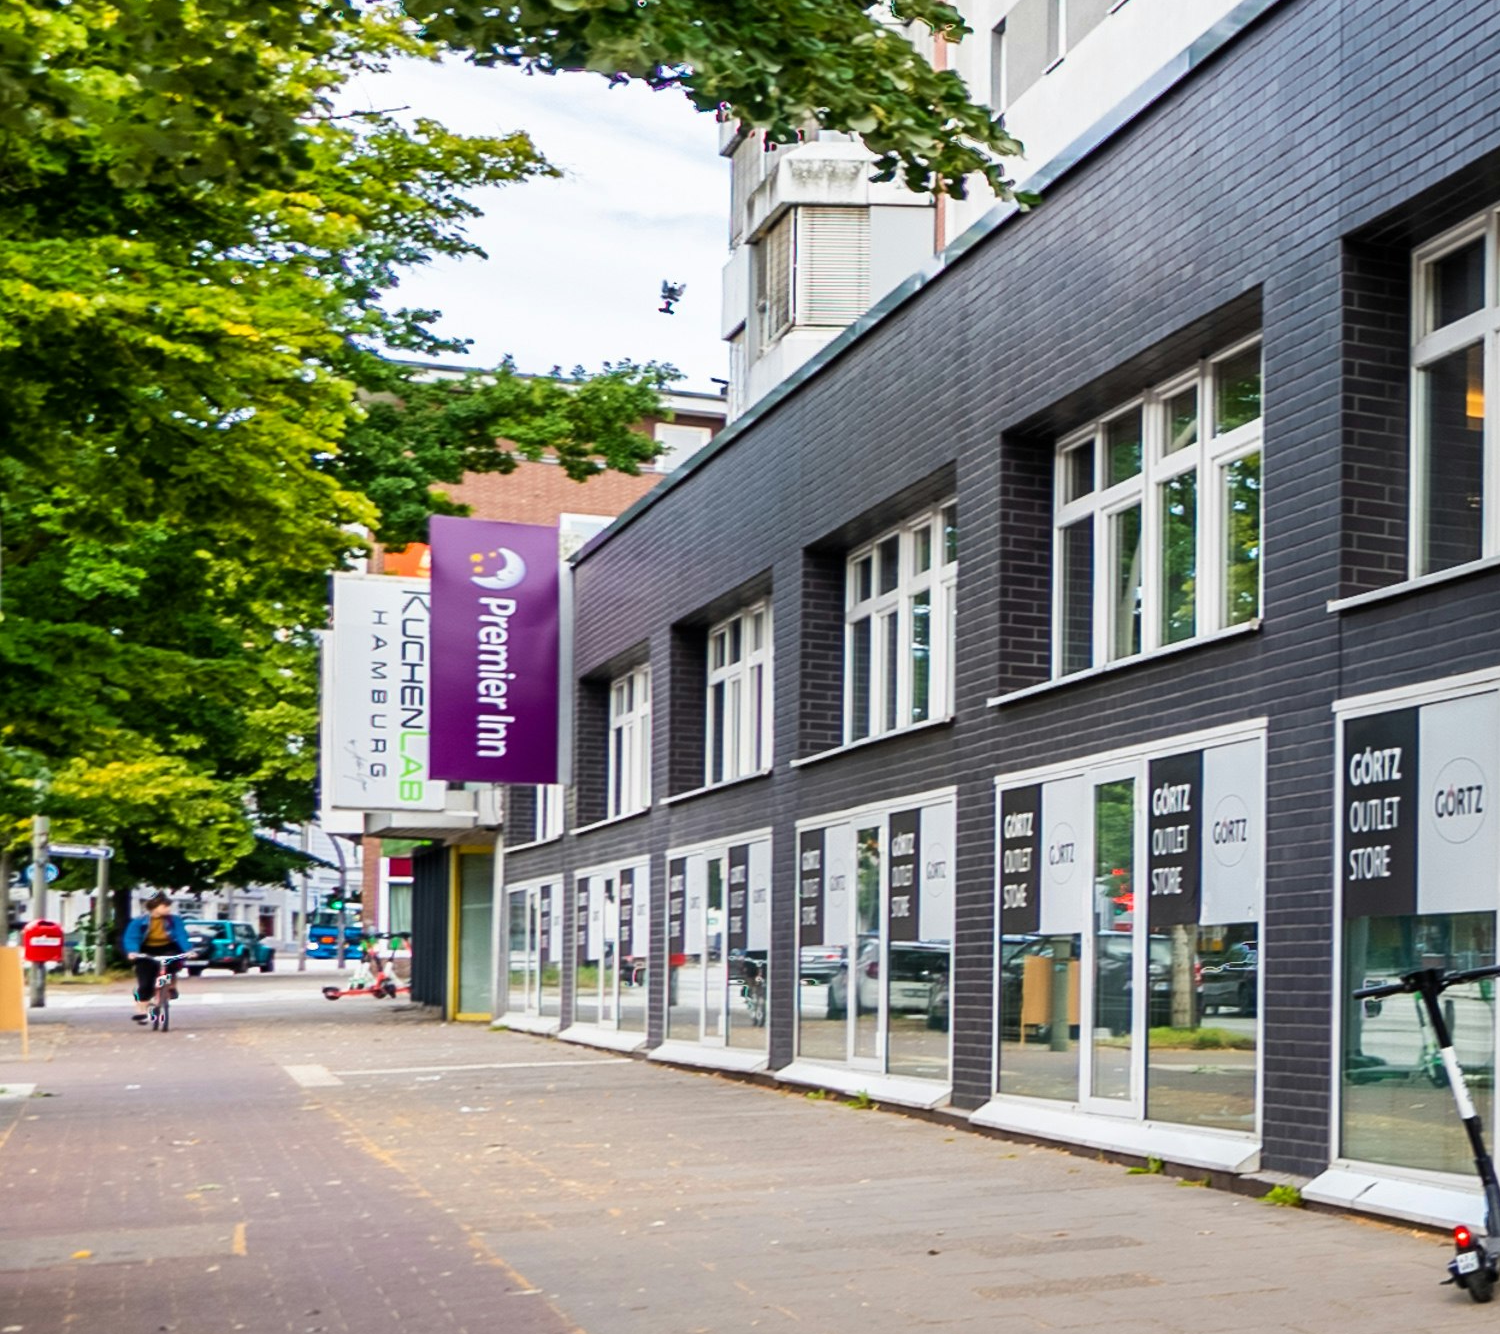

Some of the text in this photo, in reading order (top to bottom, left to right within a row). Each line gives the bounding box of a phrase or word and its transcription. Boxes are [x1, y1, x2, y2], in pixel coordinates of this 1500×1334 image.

[369, 609, 388, 778] HAMBURG
[476, 596, 517, 758] Premier Inn
[1349, 796, 1401, 833] OUTLET
[1349, 845, 1391, 881] STORE
